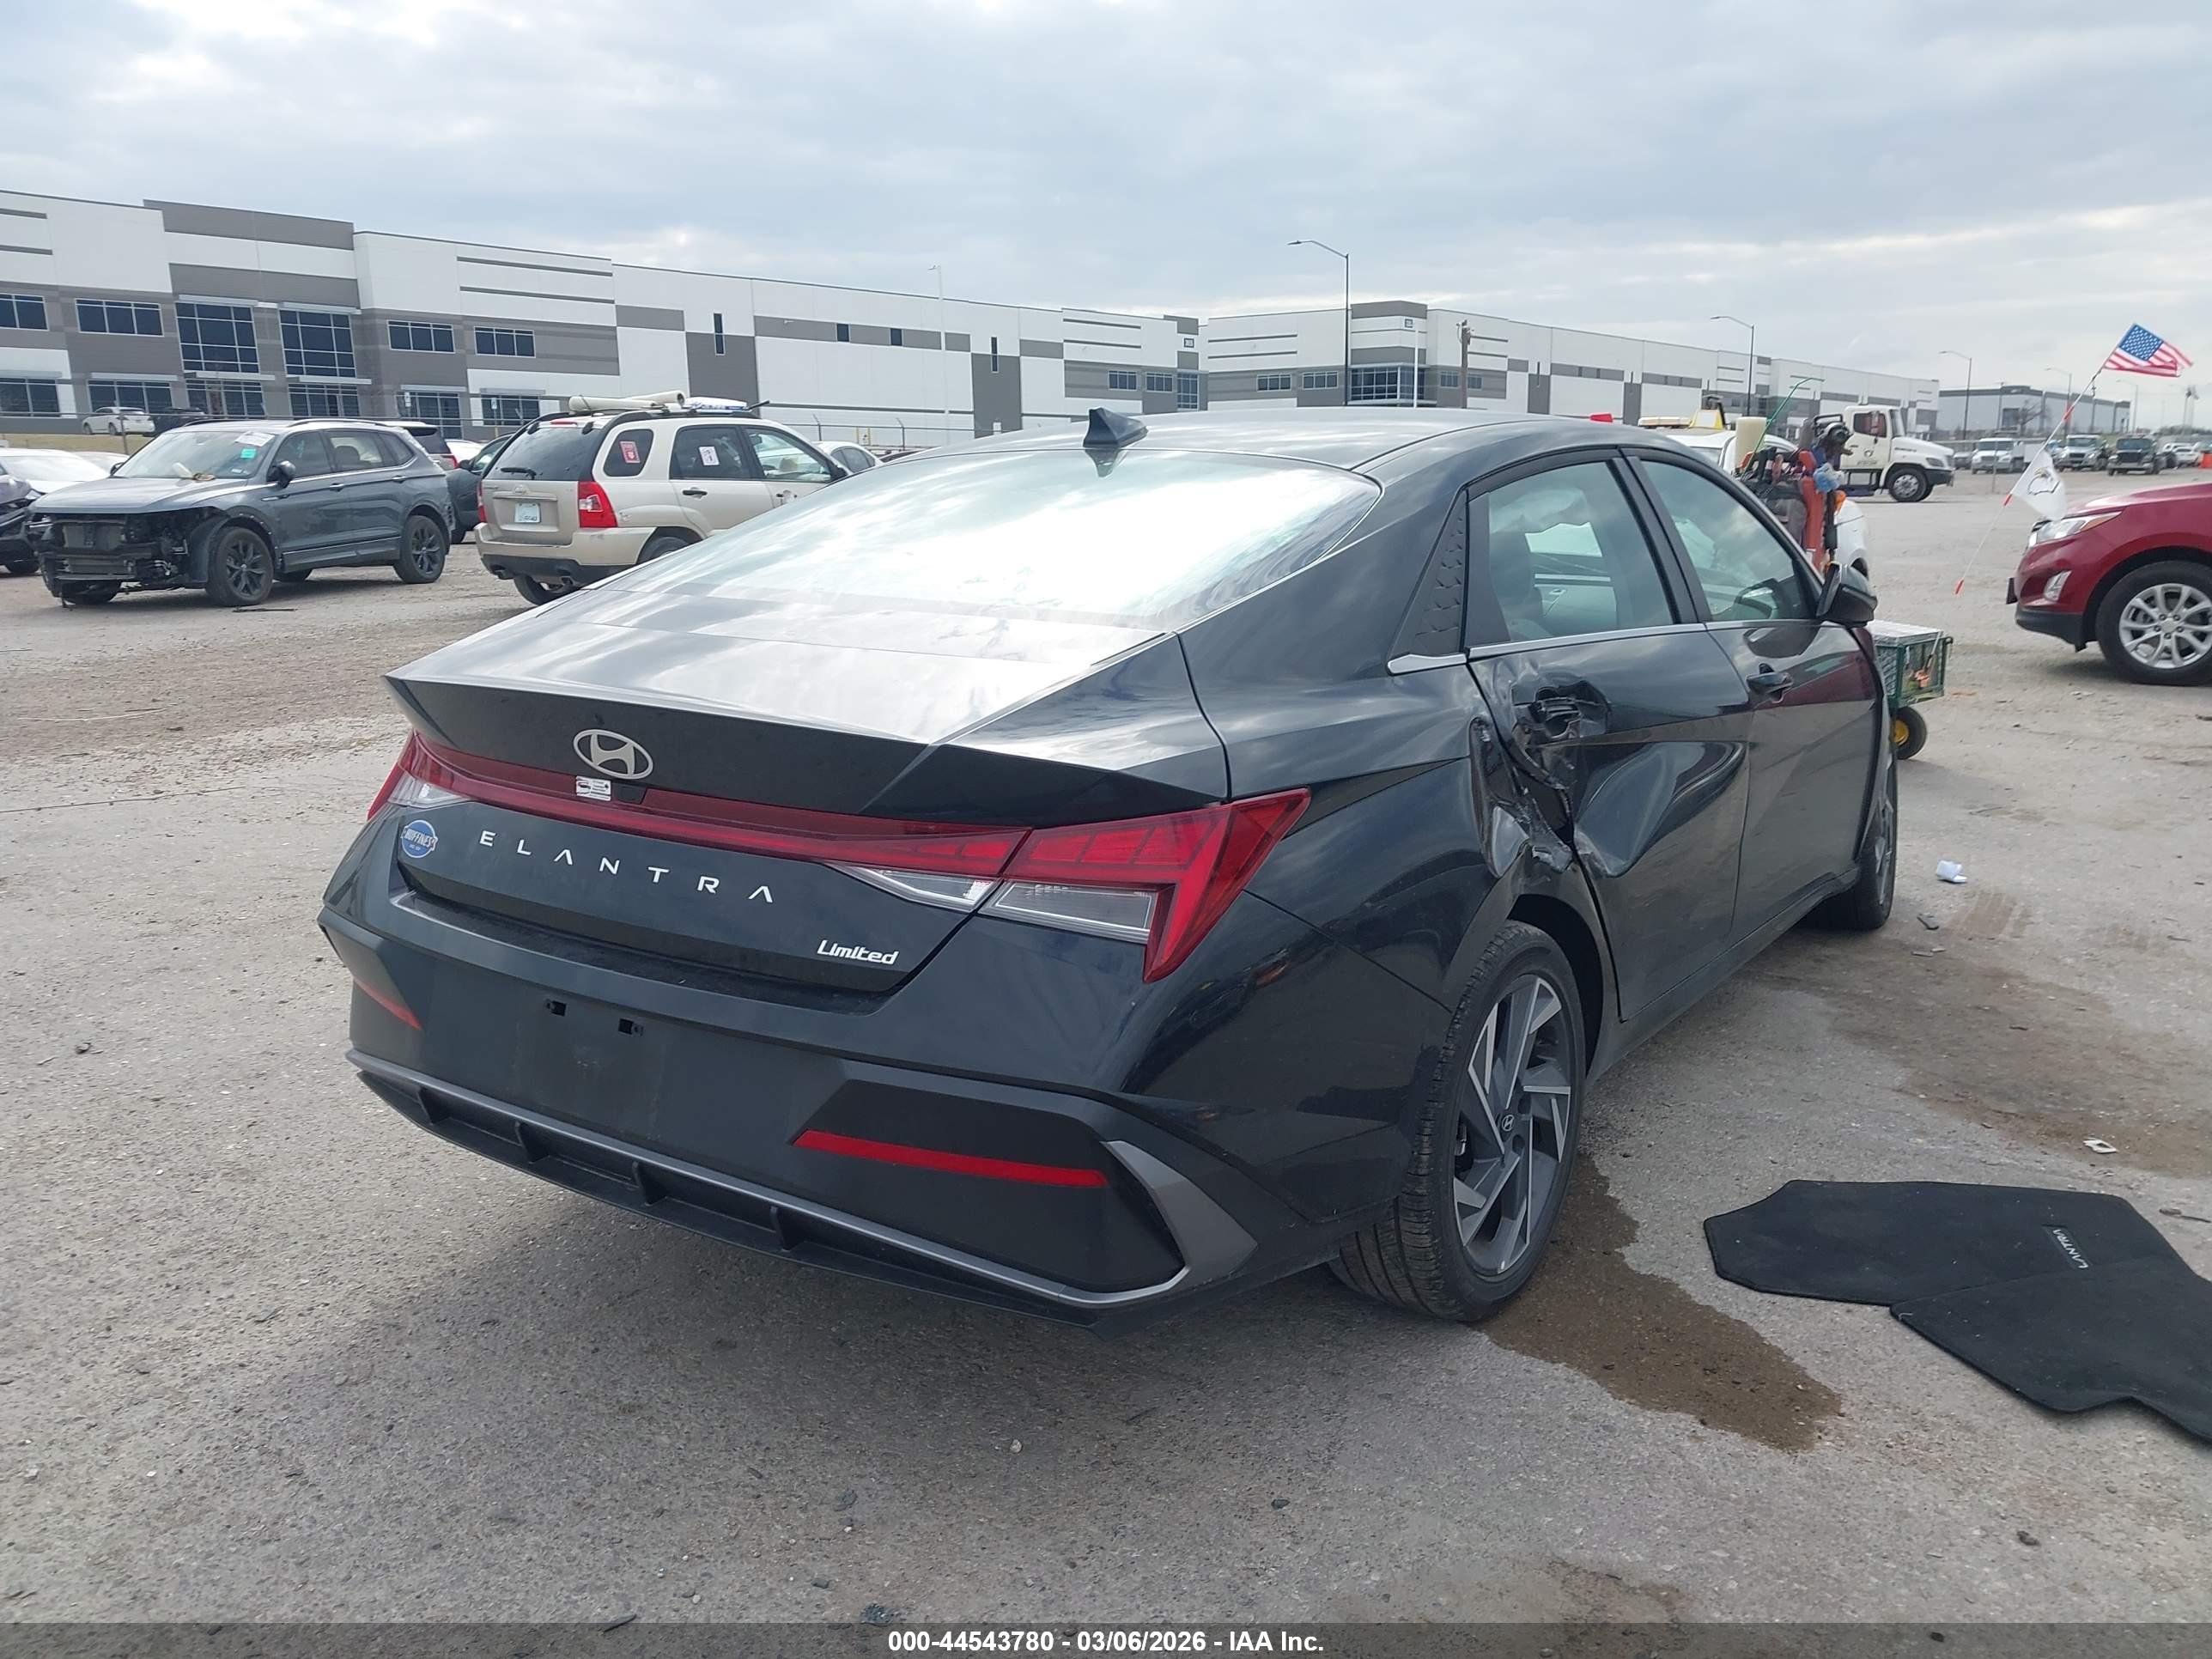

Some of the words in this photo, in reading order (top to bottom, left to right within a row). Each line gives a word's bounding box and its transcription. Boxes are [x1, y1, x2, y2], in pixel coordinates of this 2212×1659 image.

[479, 830, 774, 903] ELANTRA
[817, 939, 900, 965] Limited
[2052, 1229, 2089, 1268] LANTRA
